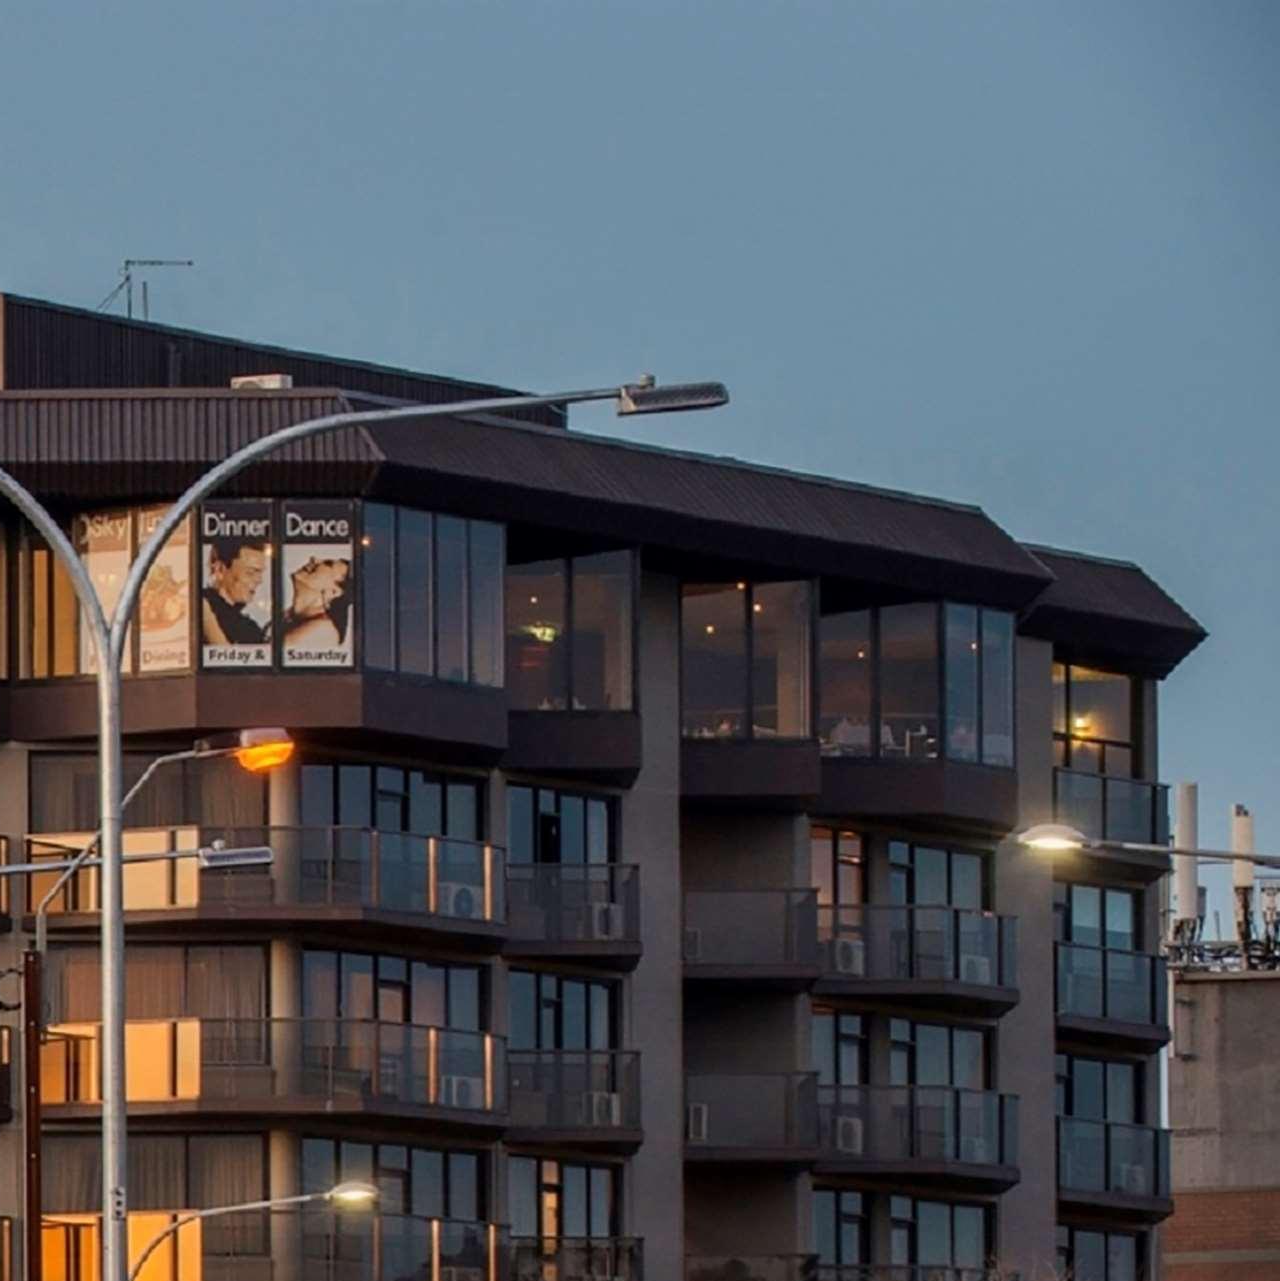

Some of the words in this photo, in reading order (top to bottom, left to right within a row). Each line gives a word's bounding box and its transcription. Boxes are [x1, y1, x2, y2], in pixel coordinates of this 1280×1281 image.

[204, 512, 270, 536] Dinner
[285, 512, 349, 537] Dance
[208, 649, 251, 664] Friday
[254, 648, 265, 661] &
[287, 649, 347, 663] Saturday
